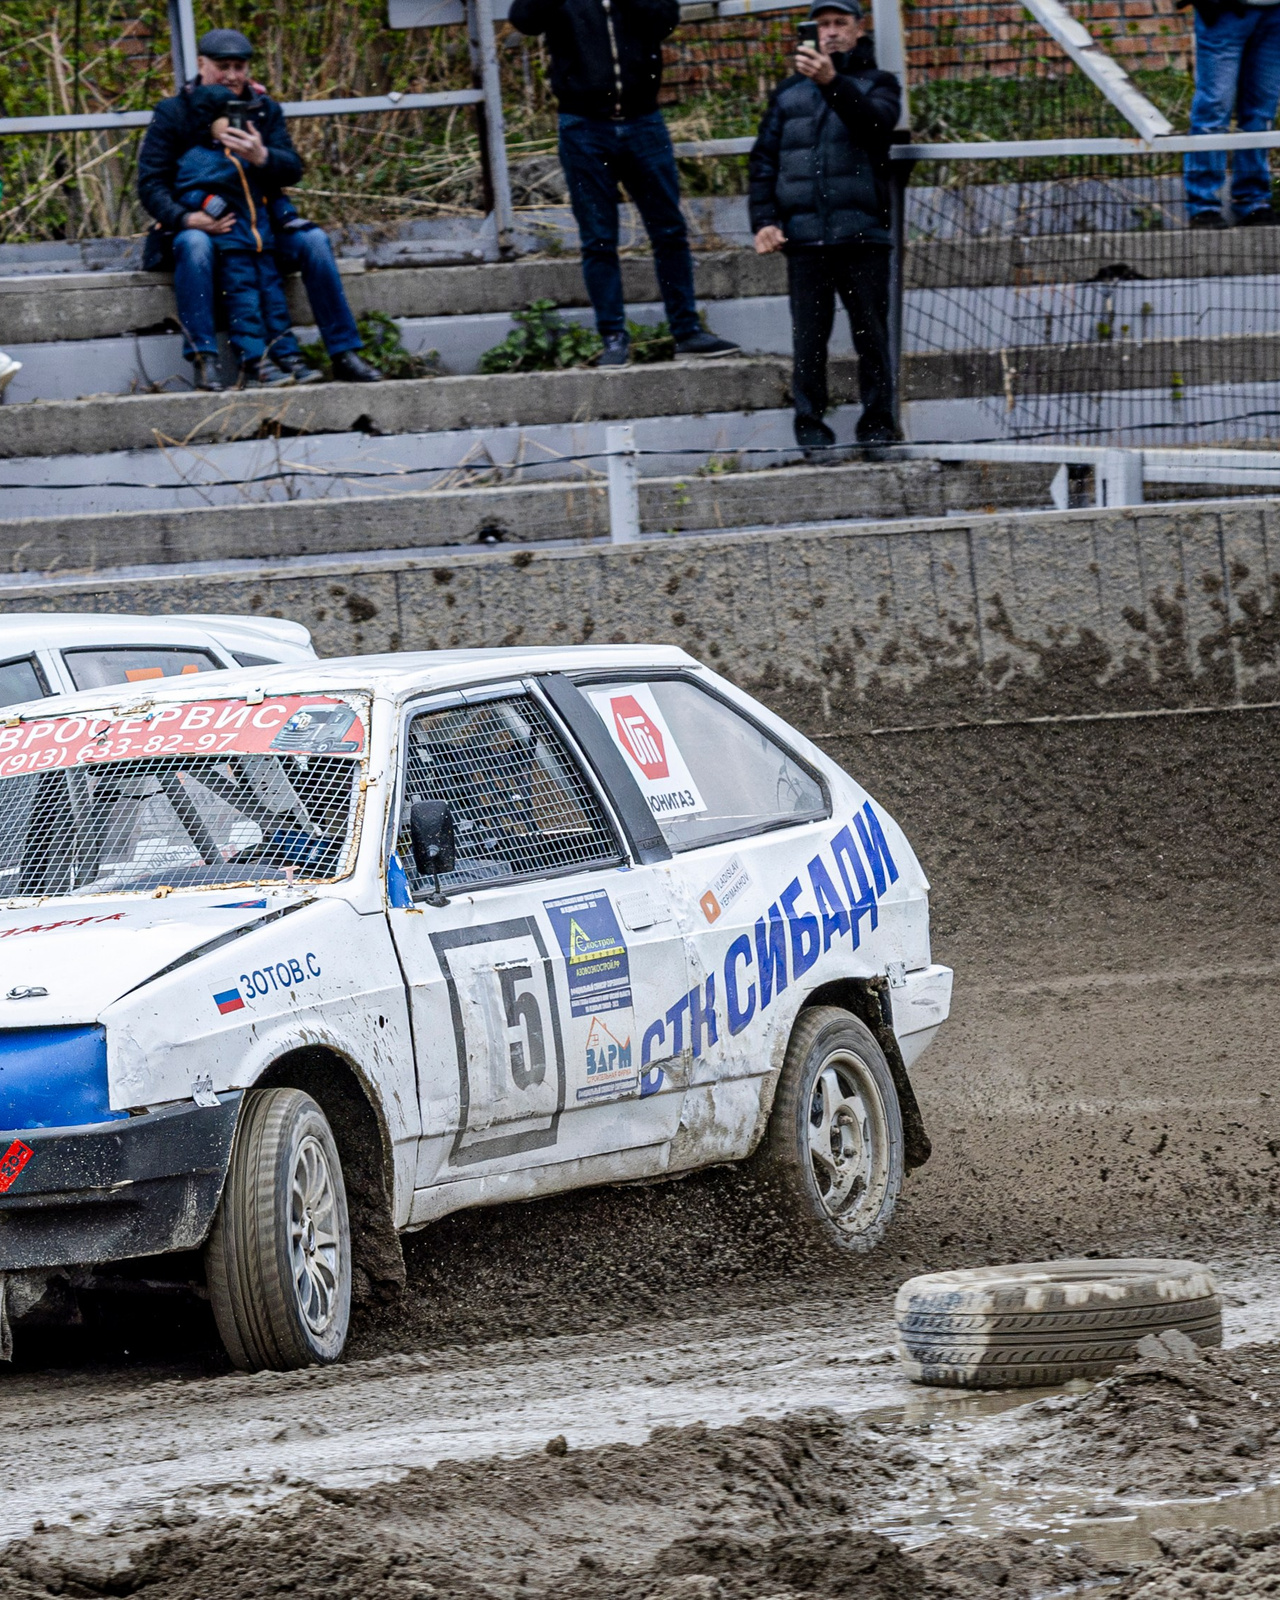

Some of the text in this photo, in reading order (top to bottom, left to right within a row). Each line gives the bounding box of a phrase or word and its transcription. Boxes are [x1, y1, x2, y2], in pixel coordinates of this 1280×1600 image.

[76, 732, 239, 762] 633-82-97
[647, 790, 696, 813] ЮНИГАЗ
[714, 860, 740, 891] VLADISLAV
[640, 800, 900, 1100] СТК СИБАДИ
[240, 952, 321, 999] ЗОТОВ.С
[494, 957, 546, 1091] 5
